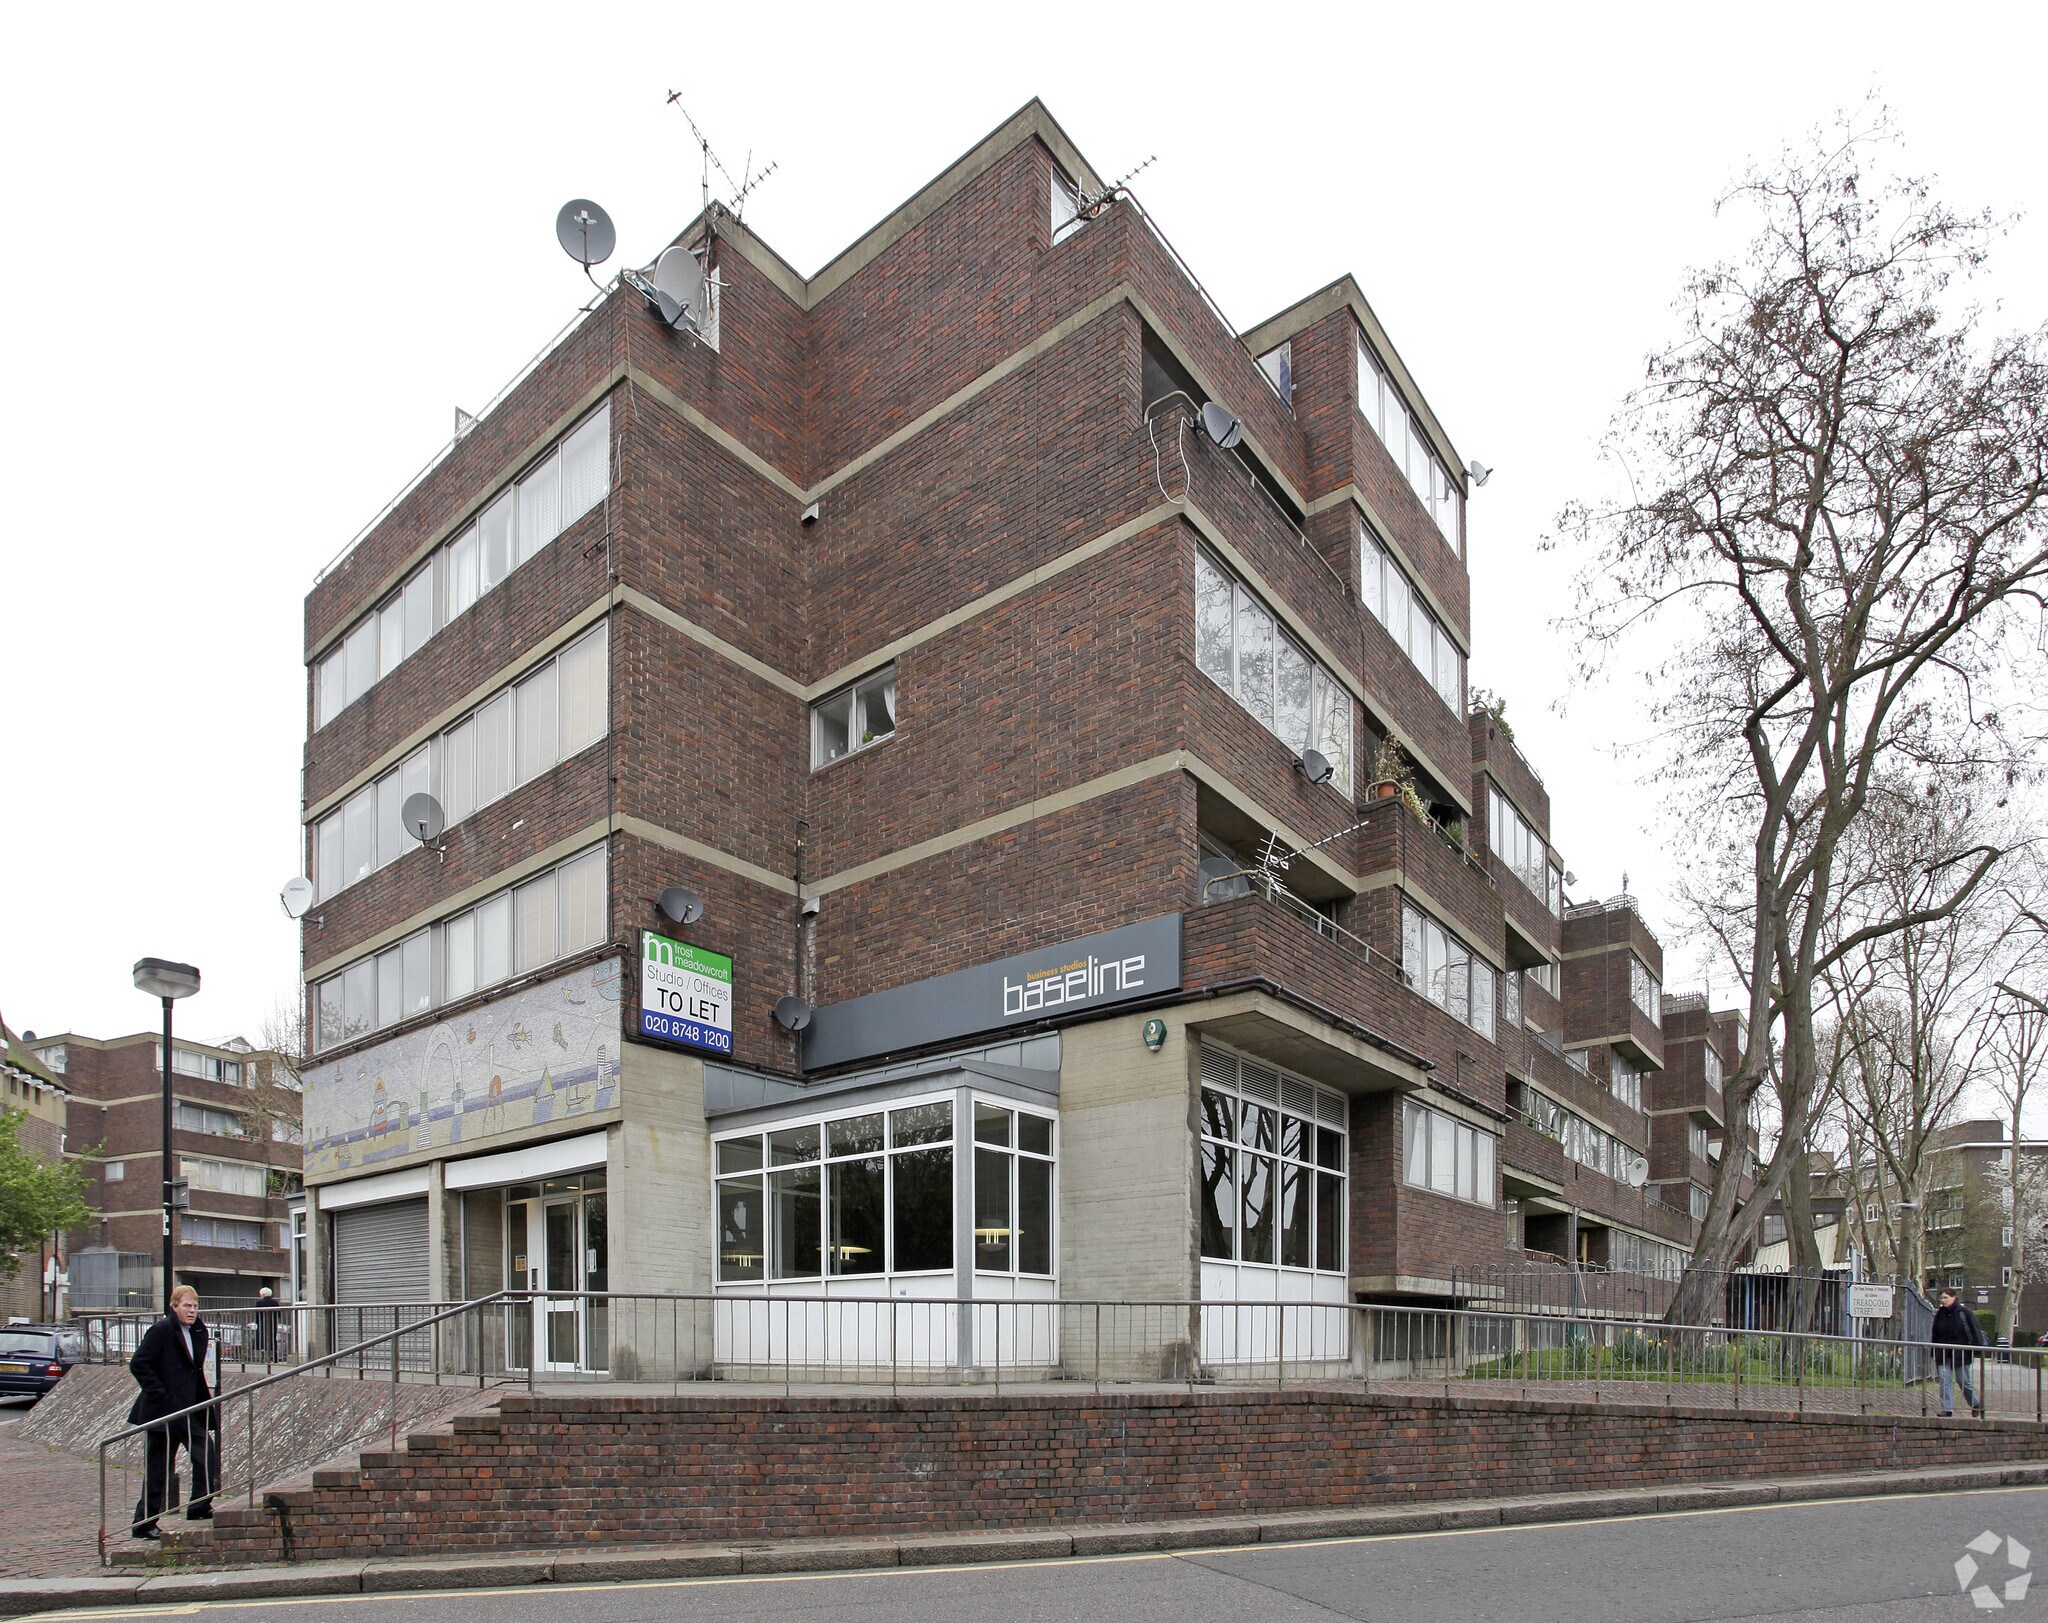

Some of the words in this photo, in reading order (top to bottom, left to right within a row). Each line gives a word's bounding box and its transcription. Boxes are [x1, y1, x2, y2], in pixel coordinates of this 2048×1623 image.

[674, 944, 693, 959] frost
[674, 956, 728, 980] meadowcroft
[1026, 967, 1059, 981] business
[1060, 960, 1087, 974] studios
[647, 964, 684, 987] Studio
[693, 978, 728, 1001] Offices
[1003, 954, 1145, 1016] baseline
[657, 987, 683, 1012] TO
[689, 997, 720, 1022] LET
[645, 1015, 669, 1033] 020
[672, 1021, 700, 1041] 8748
[703, 1029, 729, 1048] 1200
[1853, 1299, 1889, 1307] TREADGOLD
[1853, 1307, 1874, 1315] STREET
